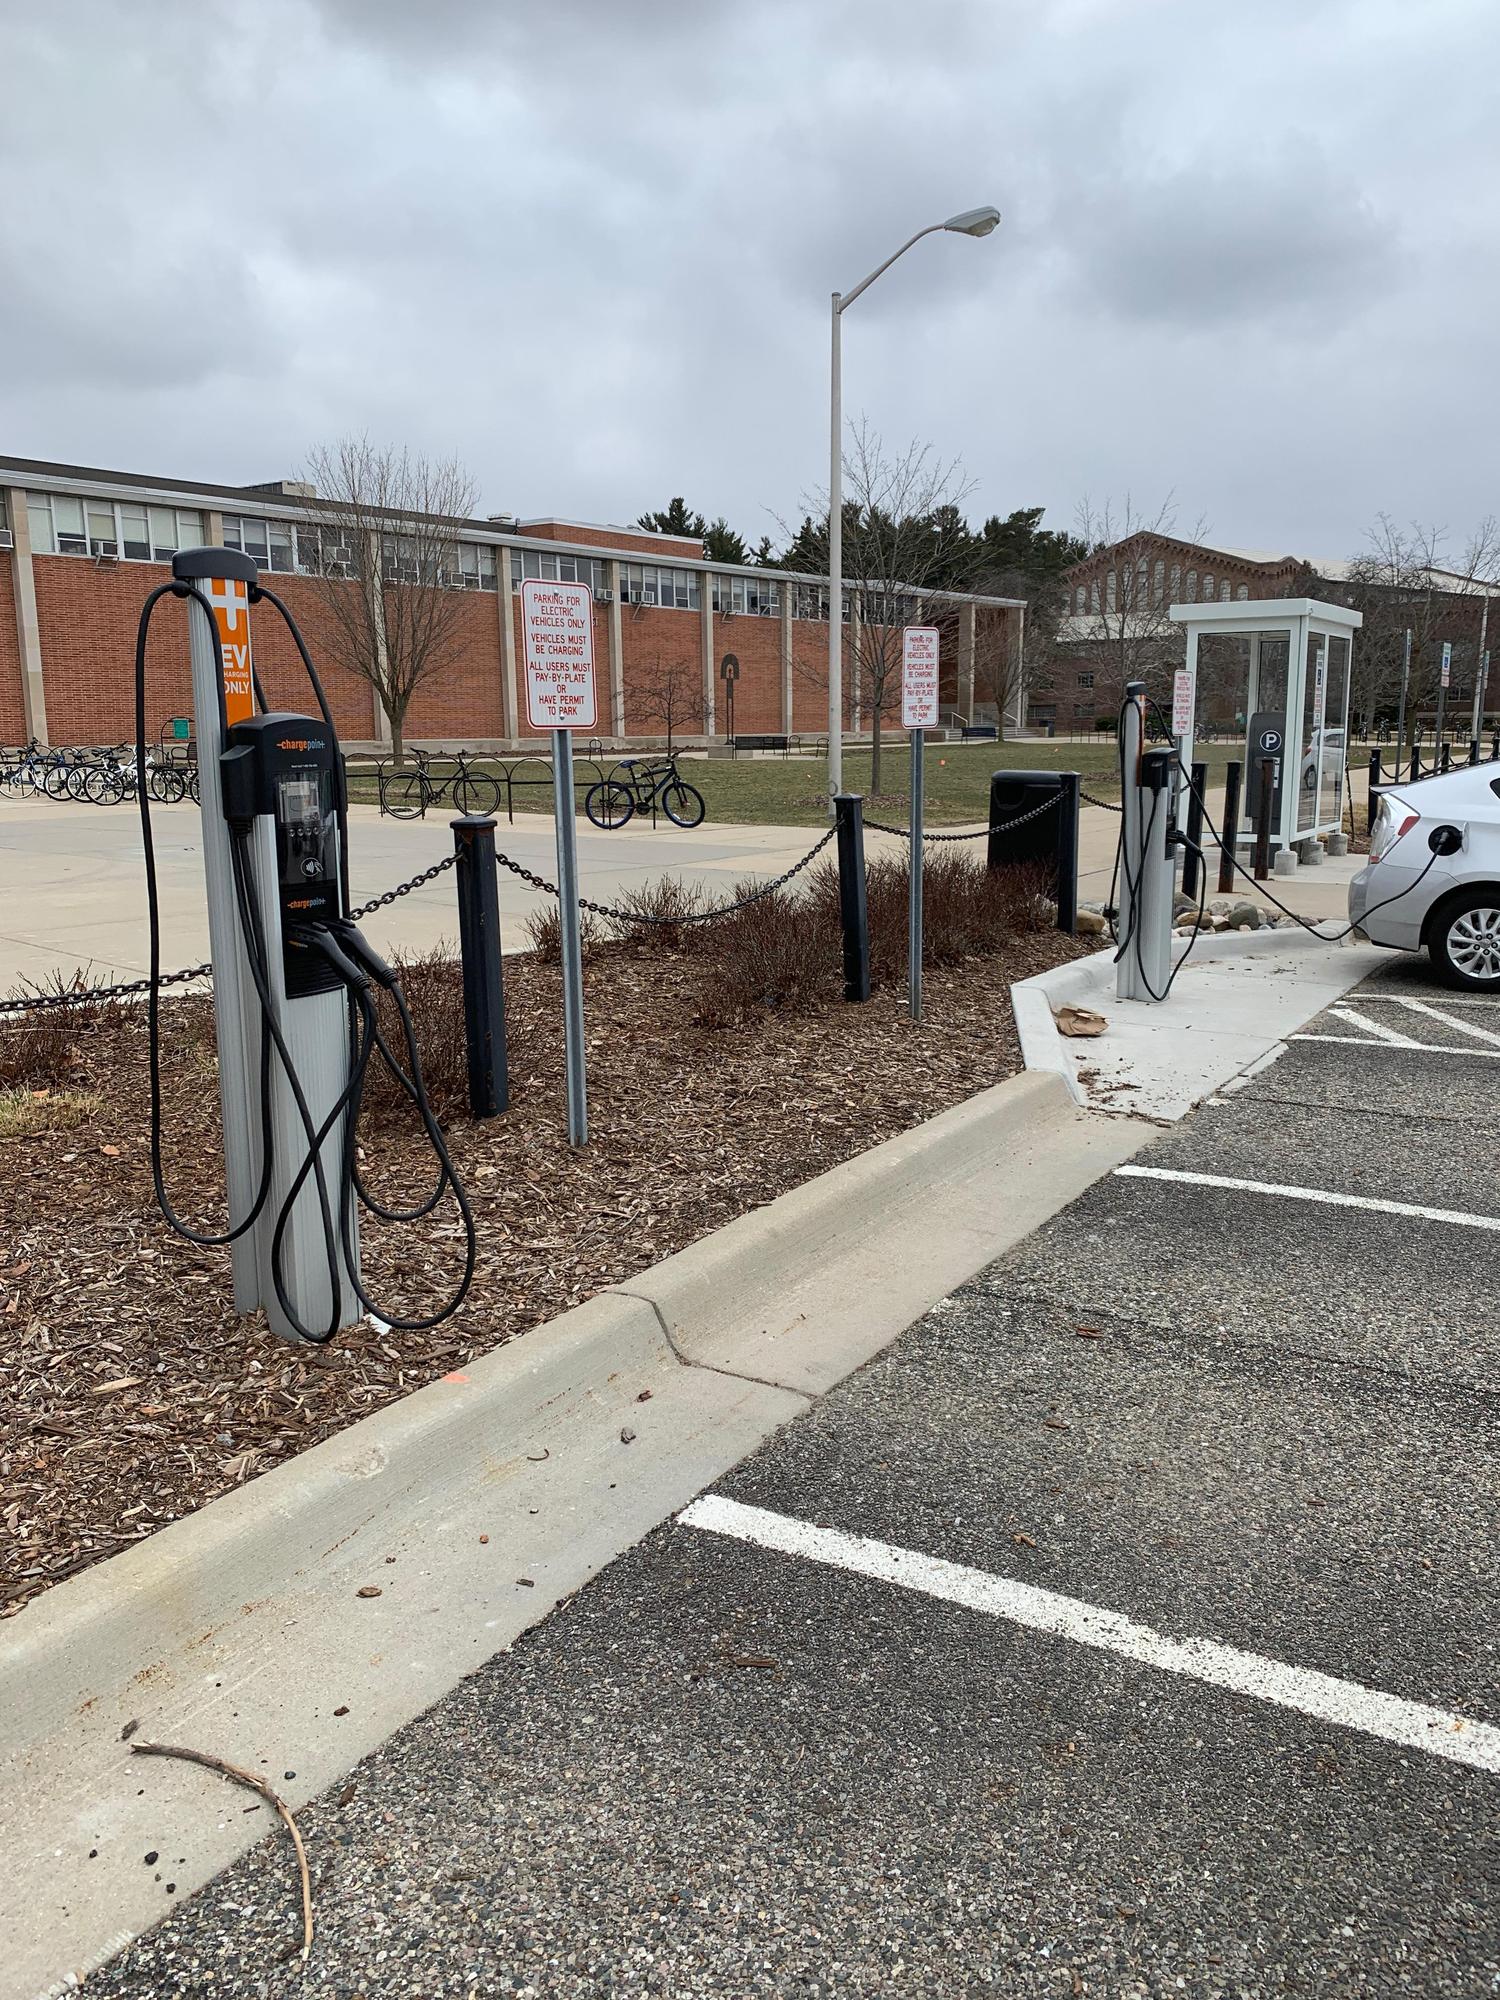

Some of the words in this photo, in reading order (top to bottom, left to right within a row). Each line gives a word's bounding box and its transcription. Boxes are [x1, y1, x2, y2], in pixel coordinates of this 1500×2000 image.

[534, 594, 563, 605] PARKING
[567, 596, 580, 605] FOR
[541, 606, 574, 616] ELECTRIC
[530, 616, 564, 627] VEHICLES
[568, 619, 585, 628] ONLY
[531, 633, 565, 643] VEHICLES
[568, 635, 586, 645] MUST
[536, 645, 544, 654] BE
[548, 646, 583, 655] CHARGING
[221, 644, 247, 668] EV
[530, 662, 543, 670] ALL
[546, 662, 569, 671] USERS
[573, 663, 590, 672] MUST
[536, 673, 586, 683] PAY-BY-PLATE
[557, 684, 566, 693] OR
[539, 696, 557, 704] HAVE
[560, 696, 584, 704] PERMIT
[548, 707, 556, 715] TO
[559, 707, 577, 715] PARK
[1266, 734, 1277, 748] P
